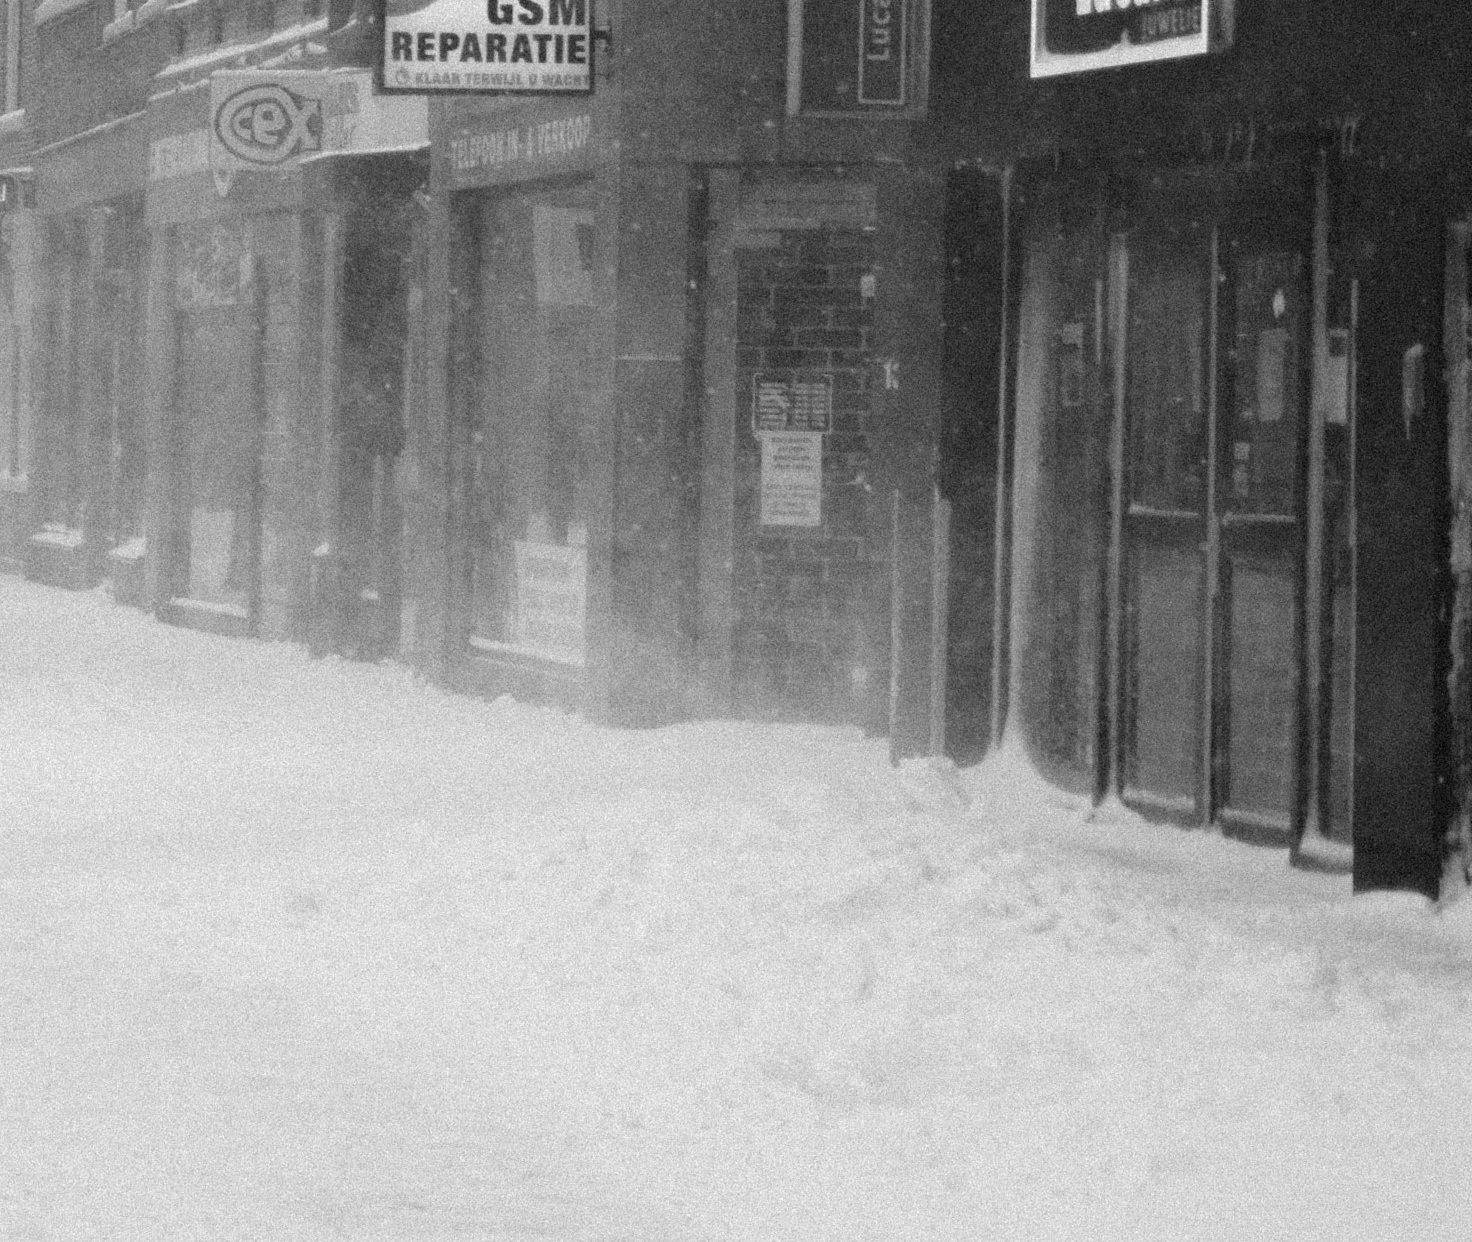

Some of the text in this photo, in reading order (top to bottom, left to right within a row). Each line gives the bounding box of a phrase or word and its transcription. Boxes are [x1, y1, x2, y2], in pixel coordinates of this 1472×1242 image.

[391, 30, 587, 65] REPARATIE
[415, 72, 461, 86] KLAAR
[464, 73, 523, 87] TERWIJL
[528, 74, 538, 87] U
[537, 115, 591, 154] VERKOOP
